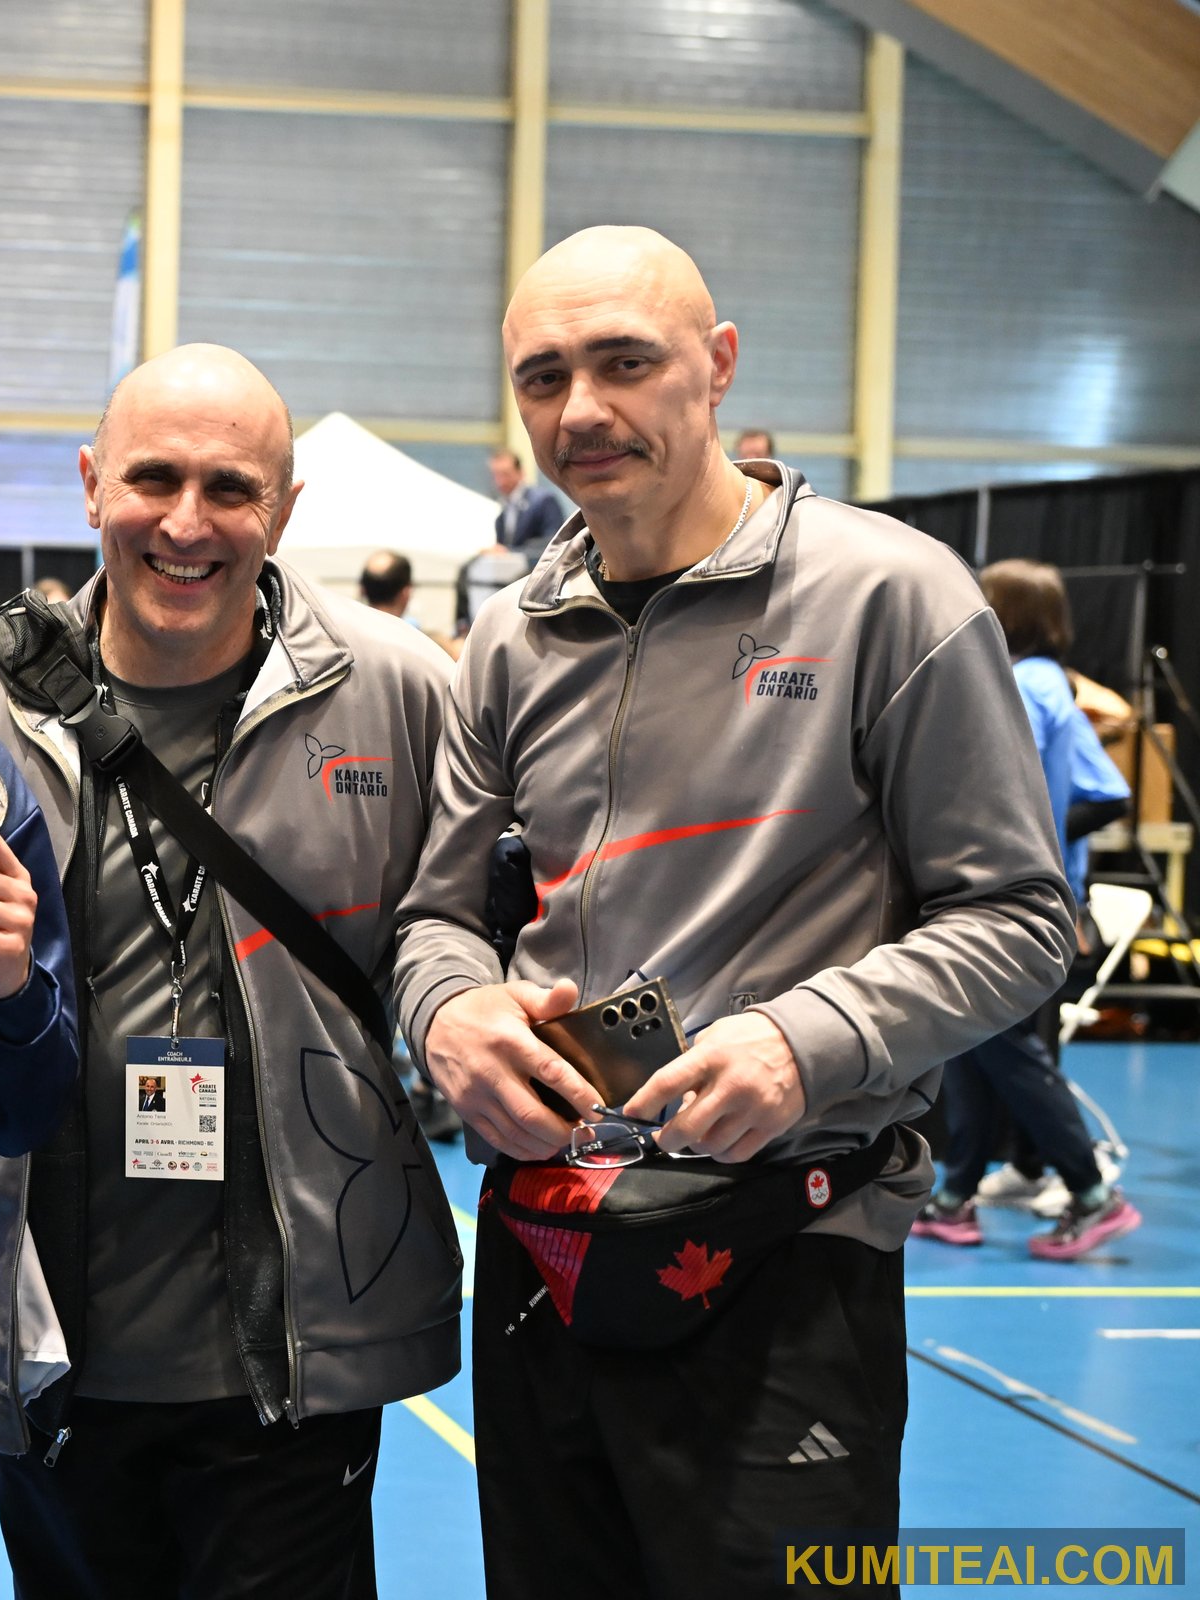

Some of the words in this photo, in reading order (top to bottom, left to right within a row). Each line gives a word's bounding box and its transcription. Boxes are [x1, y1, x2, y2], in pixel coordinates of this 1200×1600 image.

[760, 670, 816, 687] KARATE
[756, 683, 819, 701] ONTARIO
[334, 768, 383, 784] KARATE
[335, 781, 388, 798] ONTARIO
[118, 782, 131, 811] KARATE
[125, 809, 139, 839] CANADA
[190, 875, 204, 904] KARATE
[143, 872, 160, 903] KARATE
[153, 901, 172, 928] CANADA
